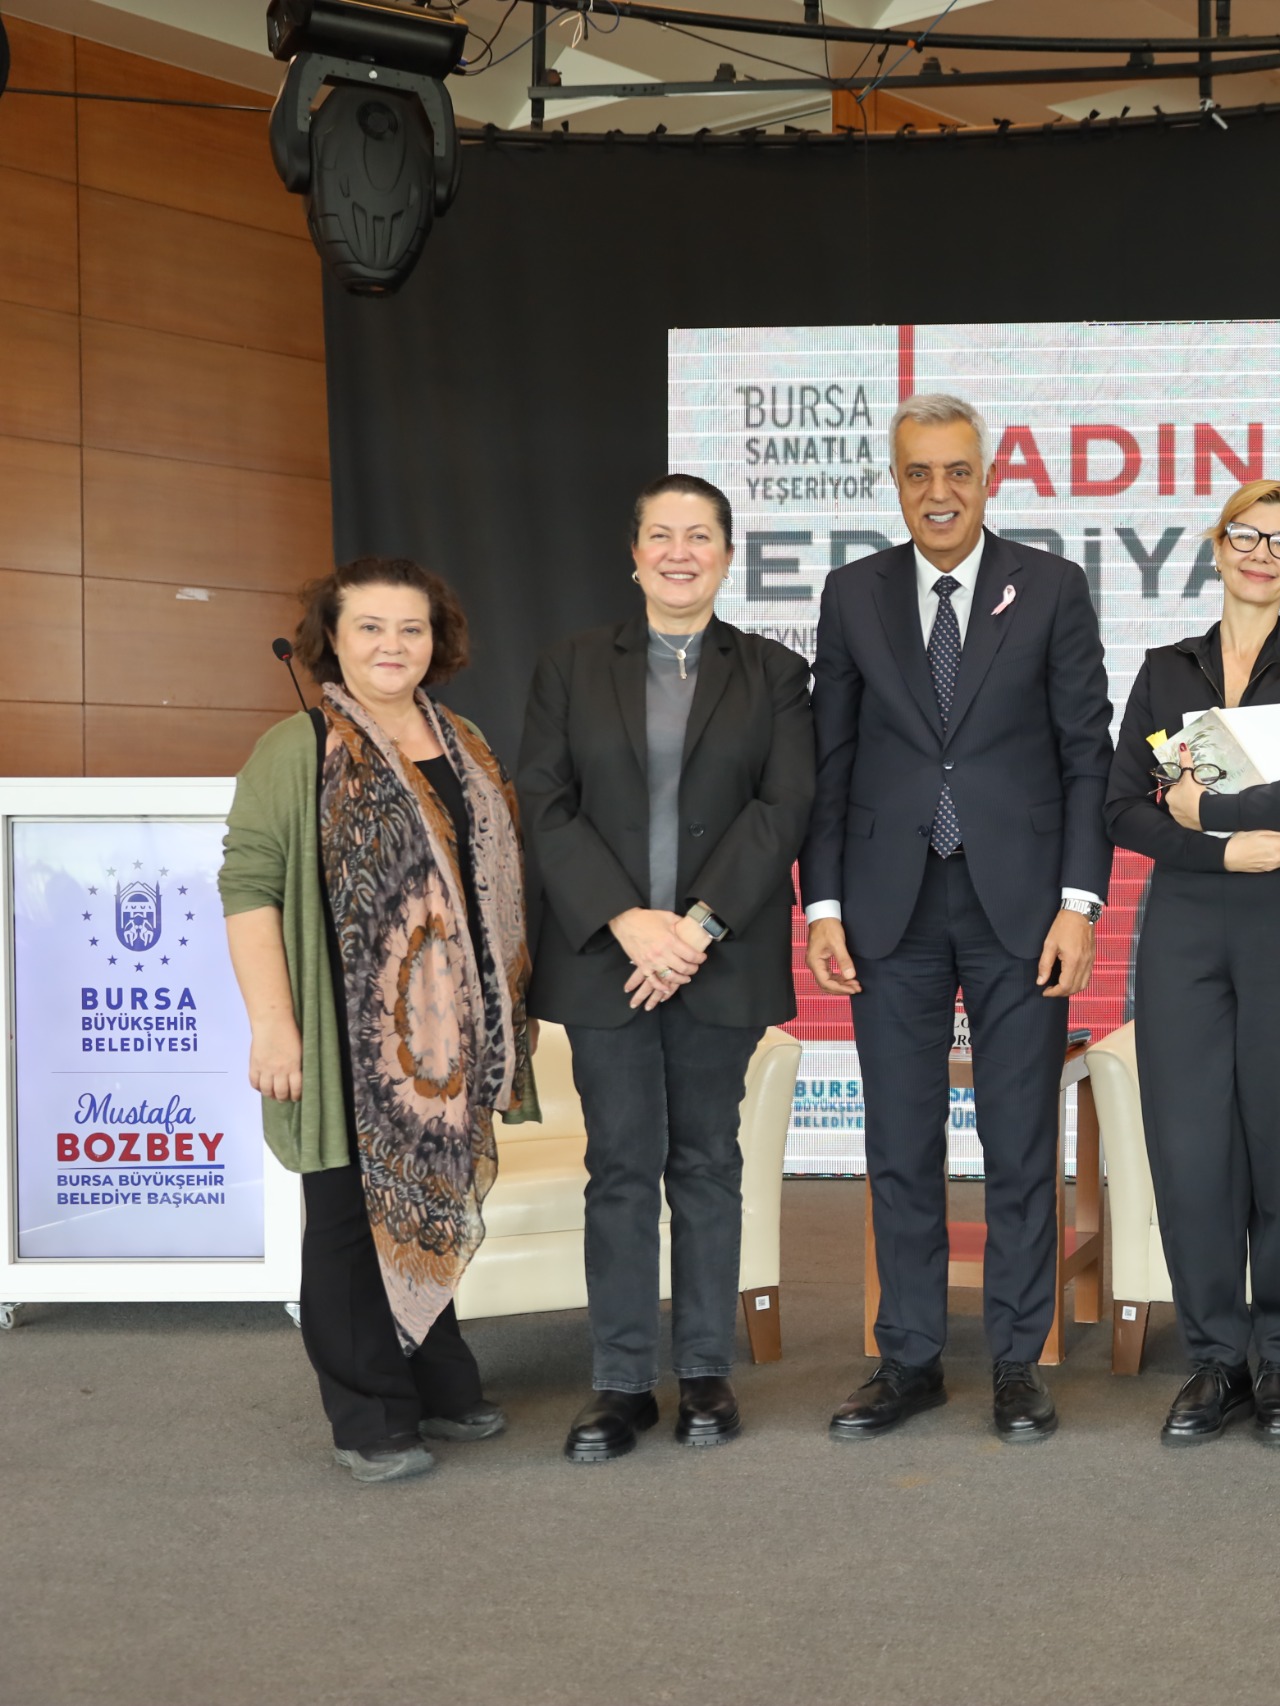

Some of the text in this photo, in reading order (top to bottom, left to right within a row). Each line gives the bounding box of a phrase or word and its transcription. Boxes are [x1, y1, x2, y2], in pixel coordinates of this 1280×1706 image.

[745, 384, 872, 428] BURSA
[746, 436, 873, 466] SANATLA
[988, 422, 1264, 498] ADIN
[746, 471, 876, 505] YEŞERİYOR
[82, 987, 196, 1010] BURSA
[82, 1011, 197, 1034] BÜYÜKŞEHİR
[82, 1032, 198, 1052] BELEDİYESİ
[74, 1092, 196, 1135] Mustafa
[57, 1132, 224, 1162] BOZBEY
[57, 1171, 225, 1190] BURSA BÜYÜKŞEHİR
[57, 1189, 226, 1209] BELEDİYE BAŞKANI
